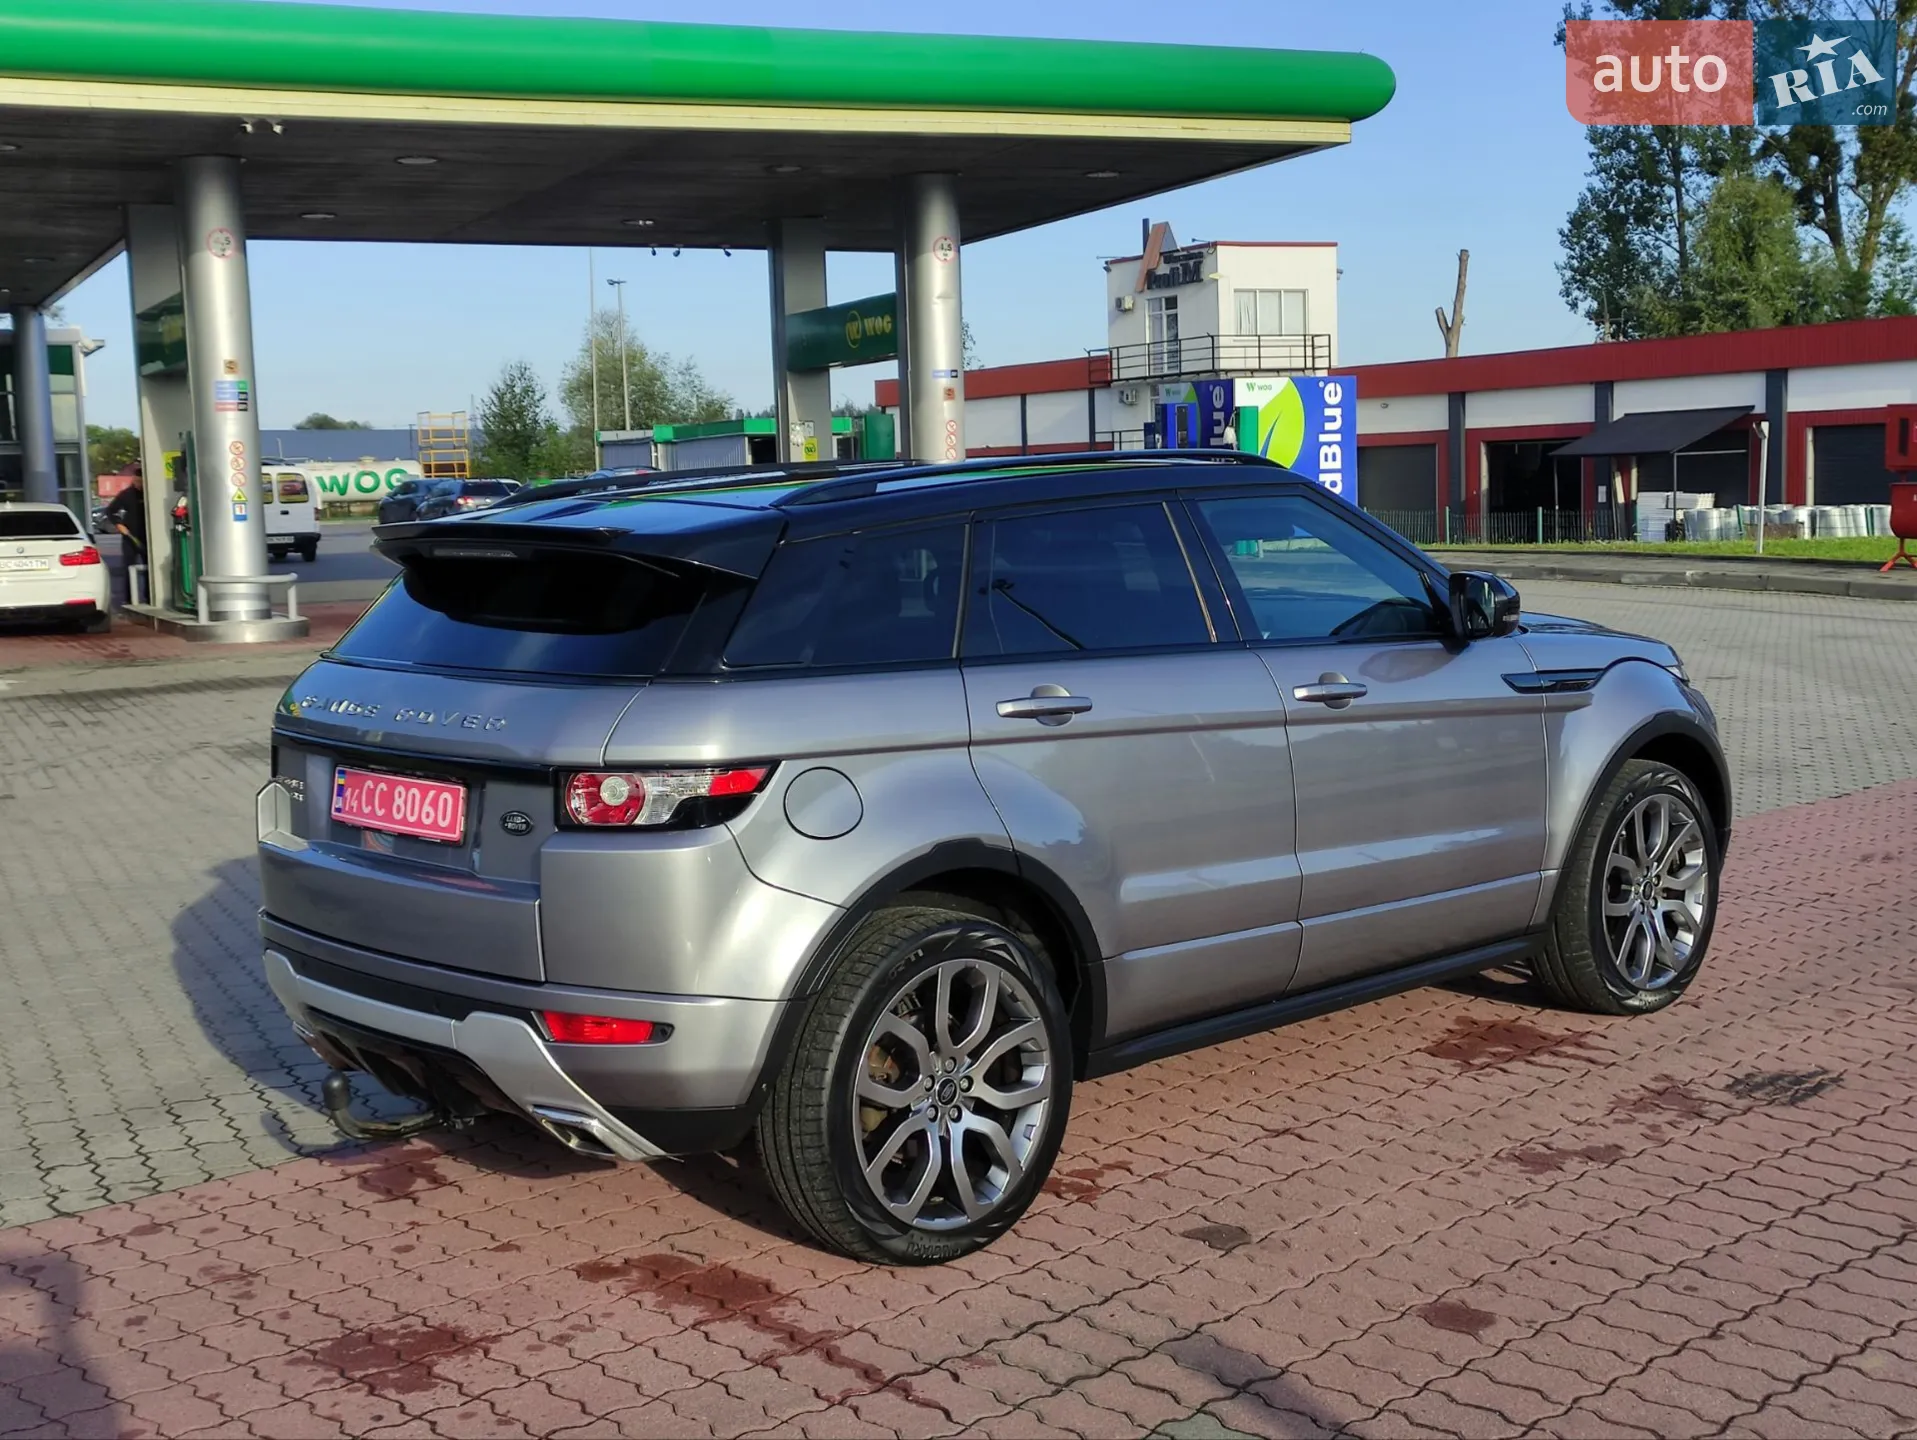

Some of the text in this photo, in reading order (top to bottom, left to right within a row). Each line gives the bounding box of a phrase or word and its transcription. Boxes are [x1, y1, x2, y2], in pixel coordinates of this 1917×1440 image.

[864, 314, 893, 338] WOG
[345, 780, 453, 828] 14 CC 8060
